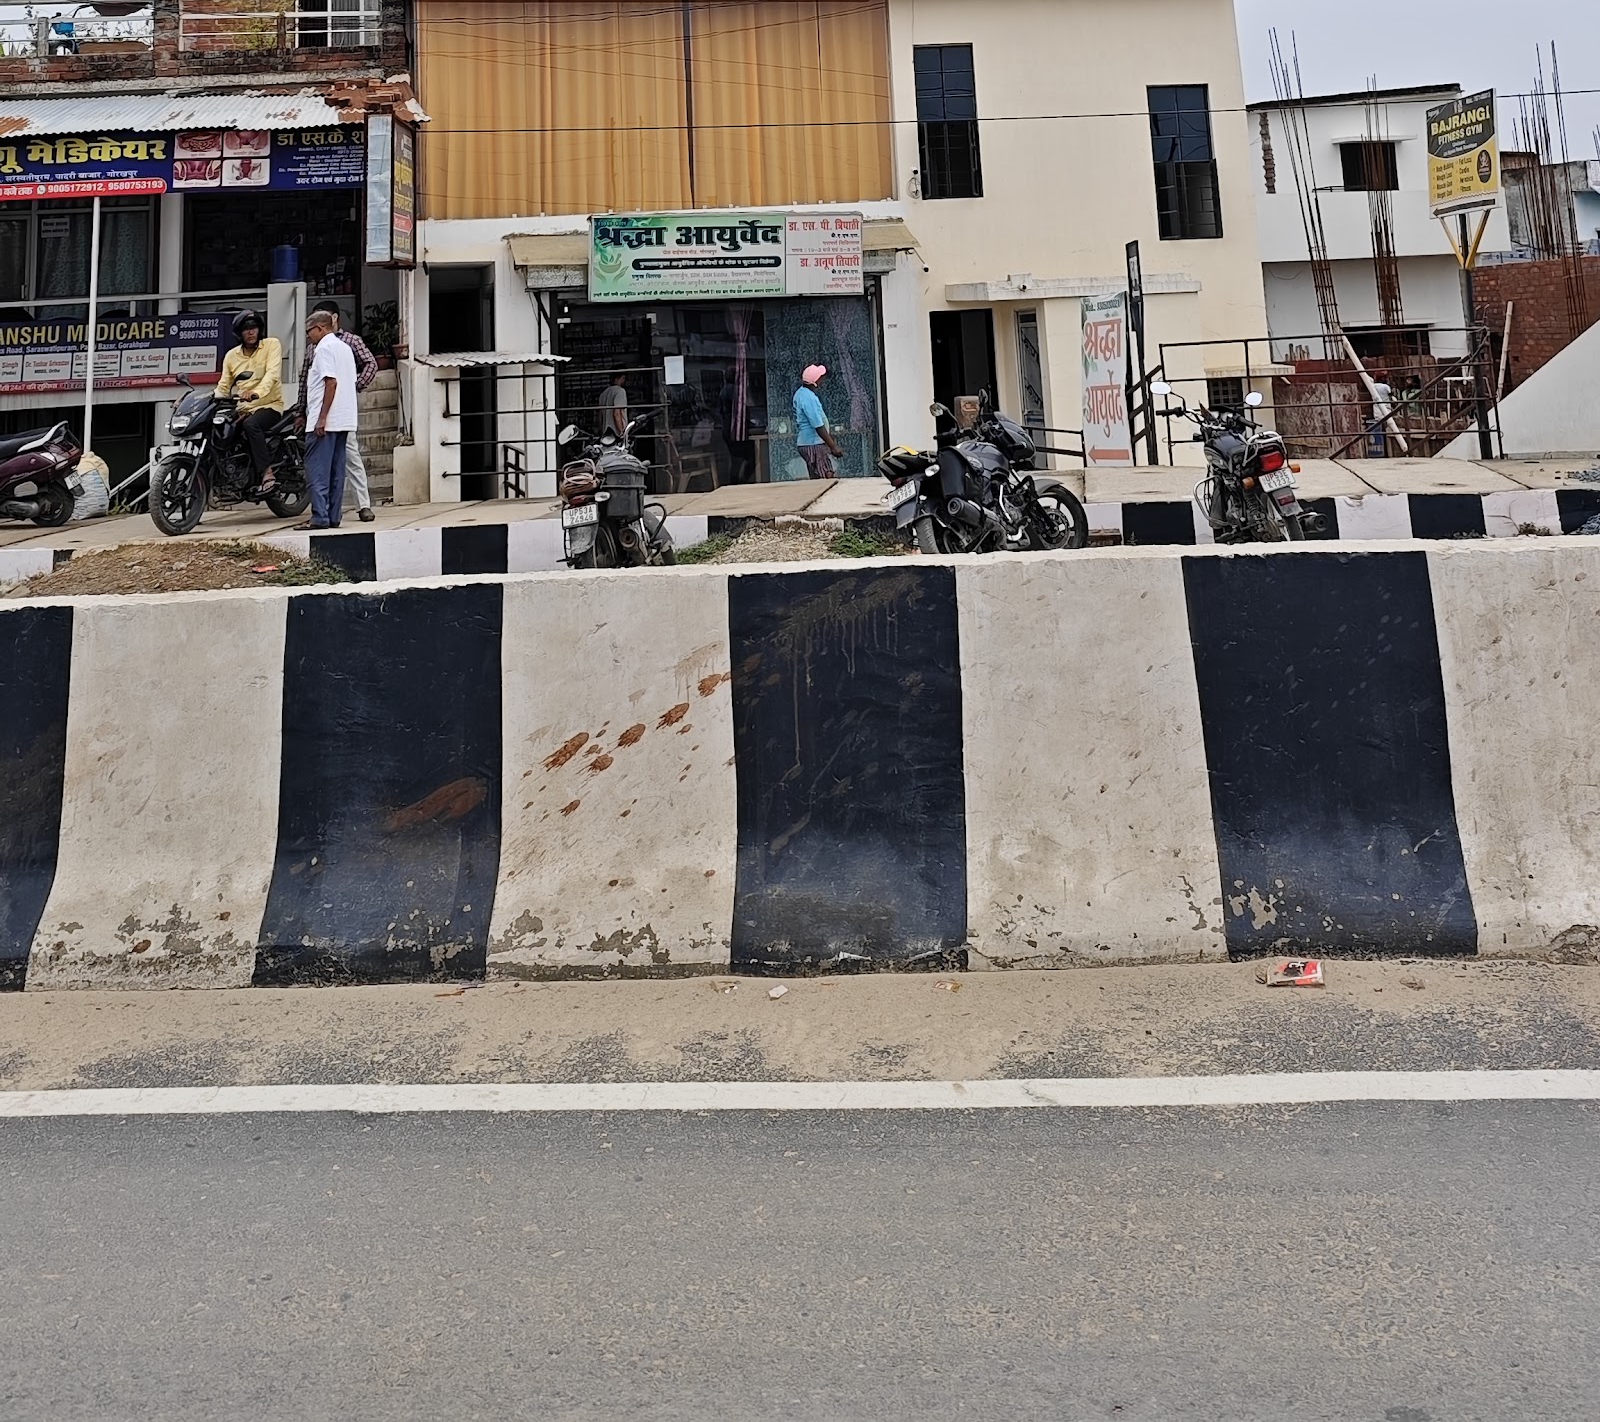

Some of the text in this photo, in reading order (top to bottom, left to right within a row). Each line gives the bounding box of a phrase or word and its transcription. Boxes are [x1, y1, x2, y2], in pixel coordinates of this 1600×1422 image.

[1431, 105, 1490, 136] BAJRANGI
[1438, 128, 1465, 145] FITNESS
[1465, 123, 1483, 136] GYM
[26, 136, 167, 164] मेडिकेयर
[597, 220, 783, 252] श्रद्धा आयुर्वेद
[1084, 318, 1122, 362] श्रद्धा
[1085, 369, 1124, 438] आयुर्वेद
